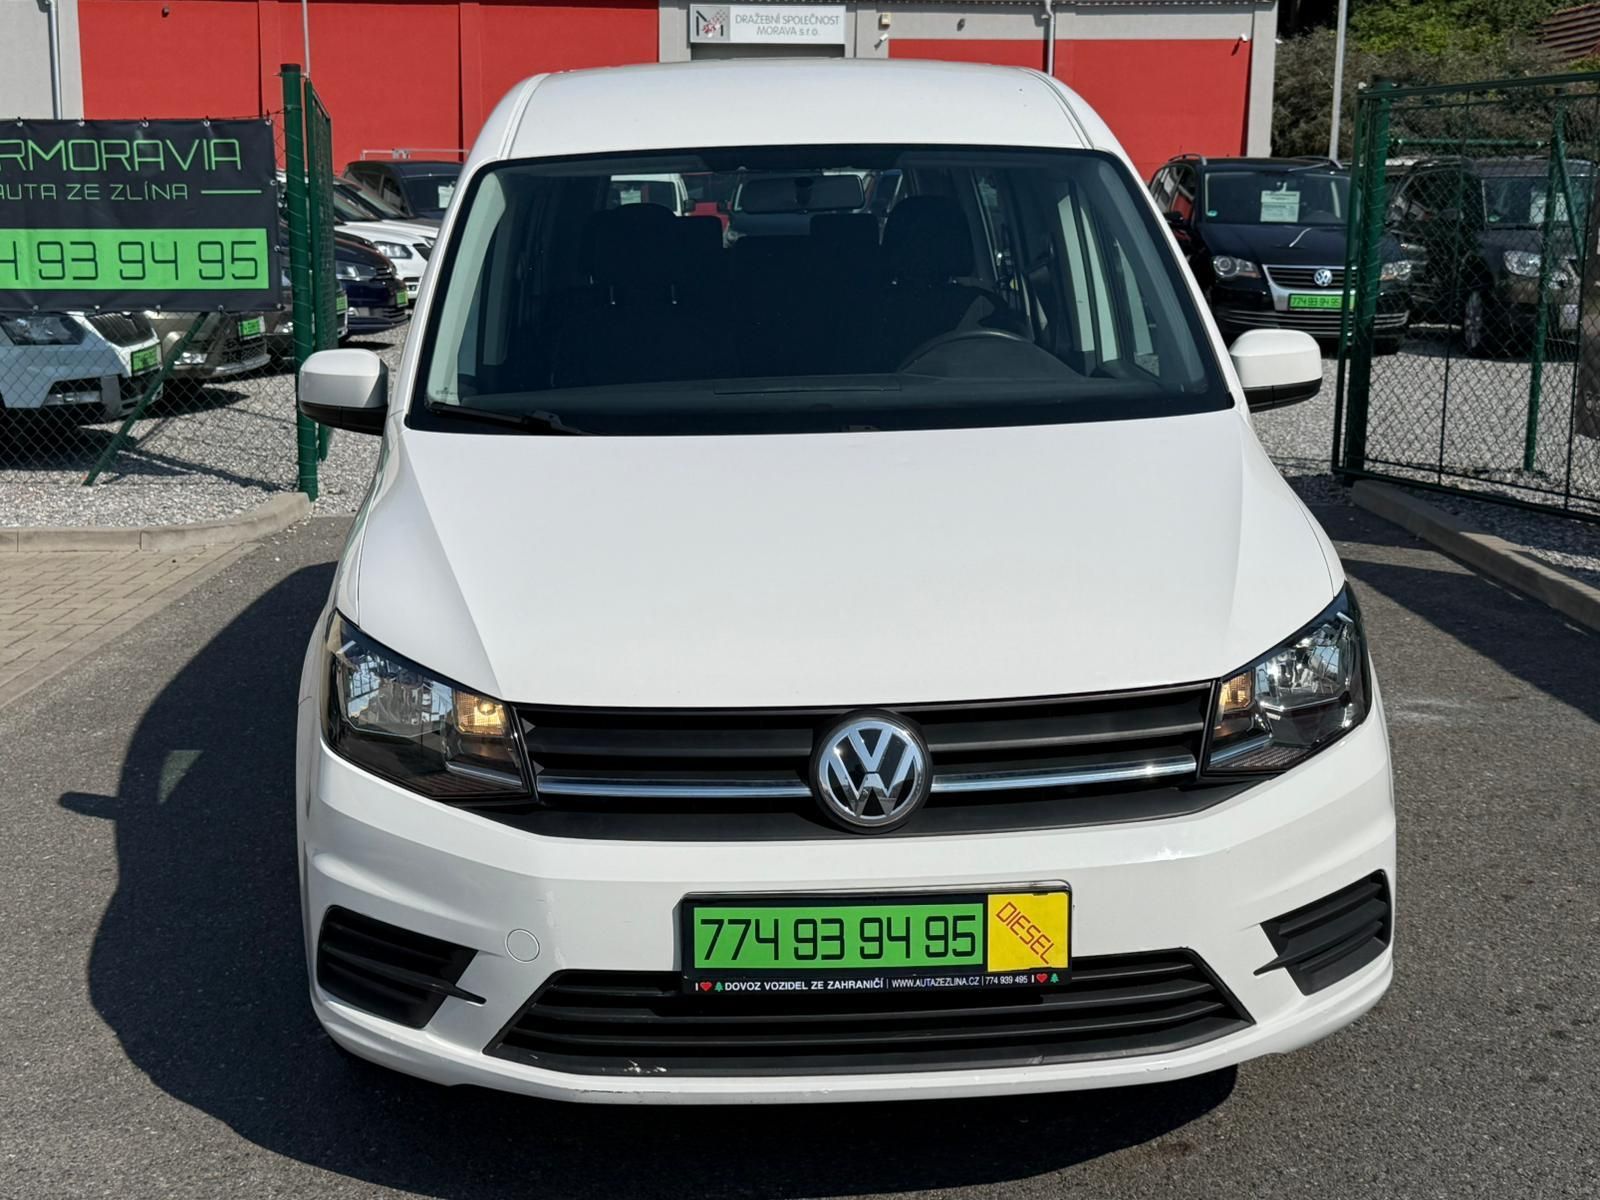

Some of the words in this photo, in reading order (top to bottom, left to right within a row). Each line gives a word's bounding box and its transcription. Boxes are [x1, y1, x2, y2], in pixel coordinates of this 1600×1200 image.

[735, 12, 781, 25] DRAŽEBNÍ
[782, 13, 840, 25] SPOLEČNOST
[756, 25, 798, 36] MORAVA
[0, 184, 57, 200] UTA
[66, 184, 100, 200] ZE
[110, 181, 188, 200] ZLÍNA
[37, 241, 98, 280] 93
[118, 240, 179, 280] 94
[198, 240, 258, 280] 95
[701, 919, 780, 960] 774
[794, 918, 845, 960] 93
[860, 917, 911, 959] 94
[925, 915, 976, 958] 95
[996, 902, 1054, 965] DIESEL
[724, 981, 762, 992] DOVOZ
[763, 980, 807, 991] VOZIDEL
[810, 980, 825, 990] ZE
[827, 977, 884, 990] ZAHRANIČÍ
[892, 976, 980, 988] WWW.AUTAZEZLINA.CZ
[985, 976, 999, 985] 774
[999, 975, 1013, 985] 939
[1014, 975, 1028, 984] 495
